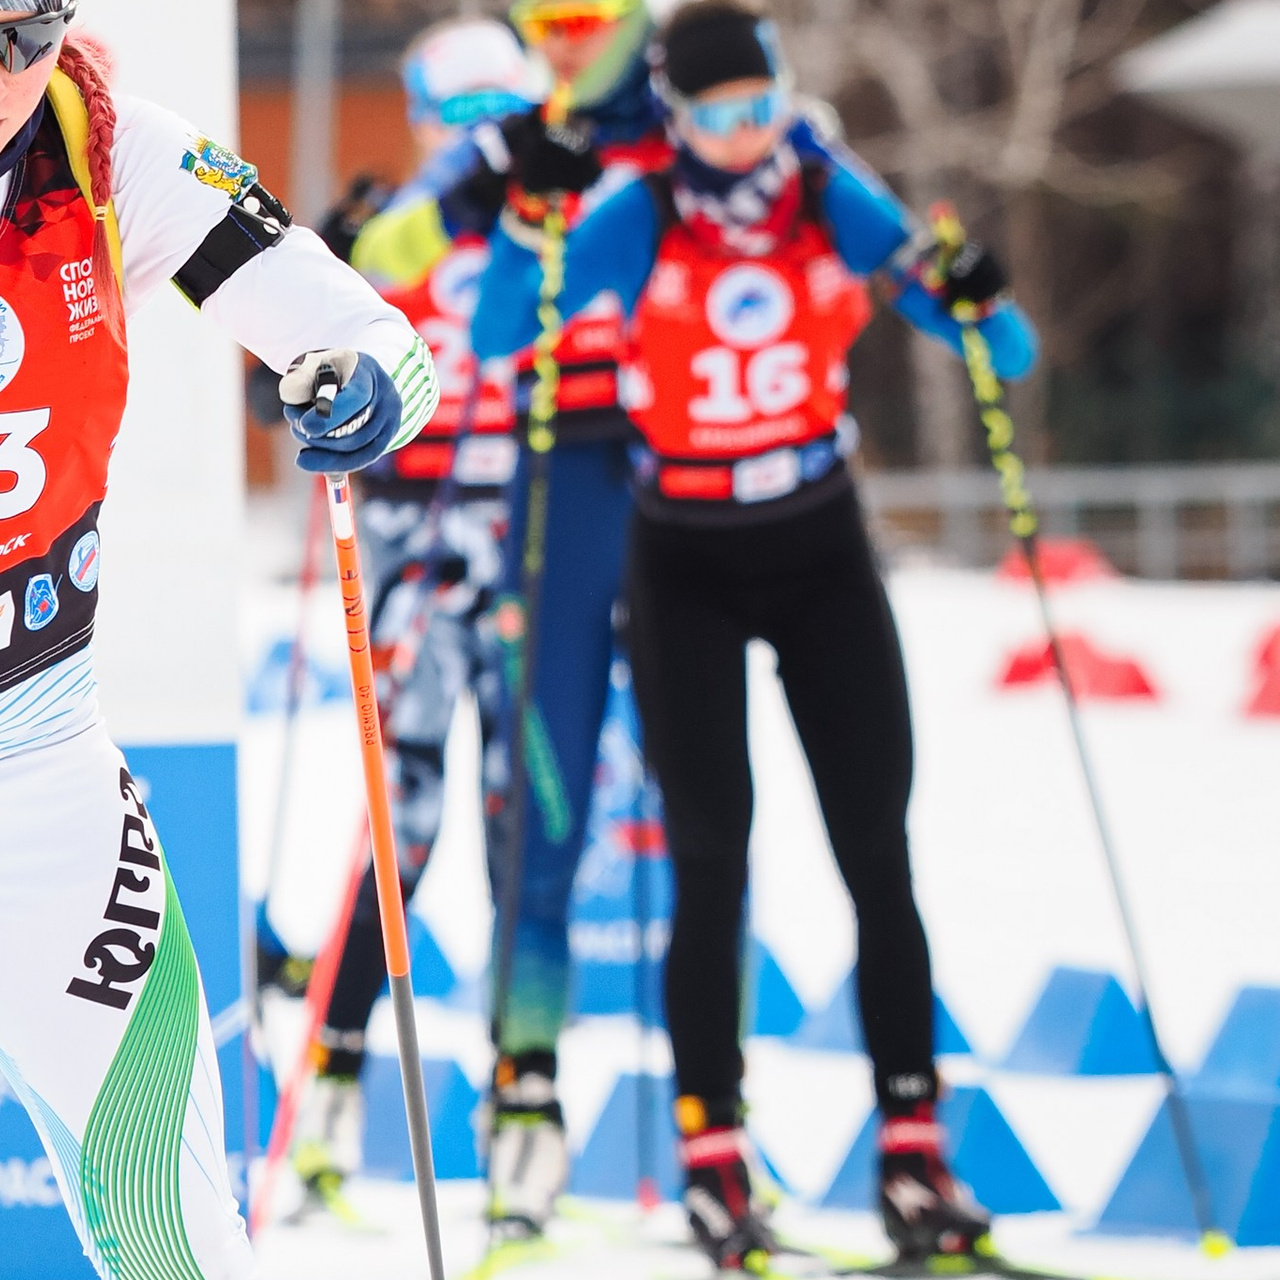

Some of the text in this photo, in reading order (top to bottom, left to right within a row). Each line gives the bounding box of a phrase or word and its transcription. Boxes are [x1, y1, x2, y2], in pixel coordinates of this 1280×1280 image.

[59, 256, 93, 282] СПО
[62, 277, 96, 303] НОР
[66, 295, 98, 322] ЖИЗ
[689, 341, 812, 424] 16
[358, 684, 377, 746] PREMIO 40
